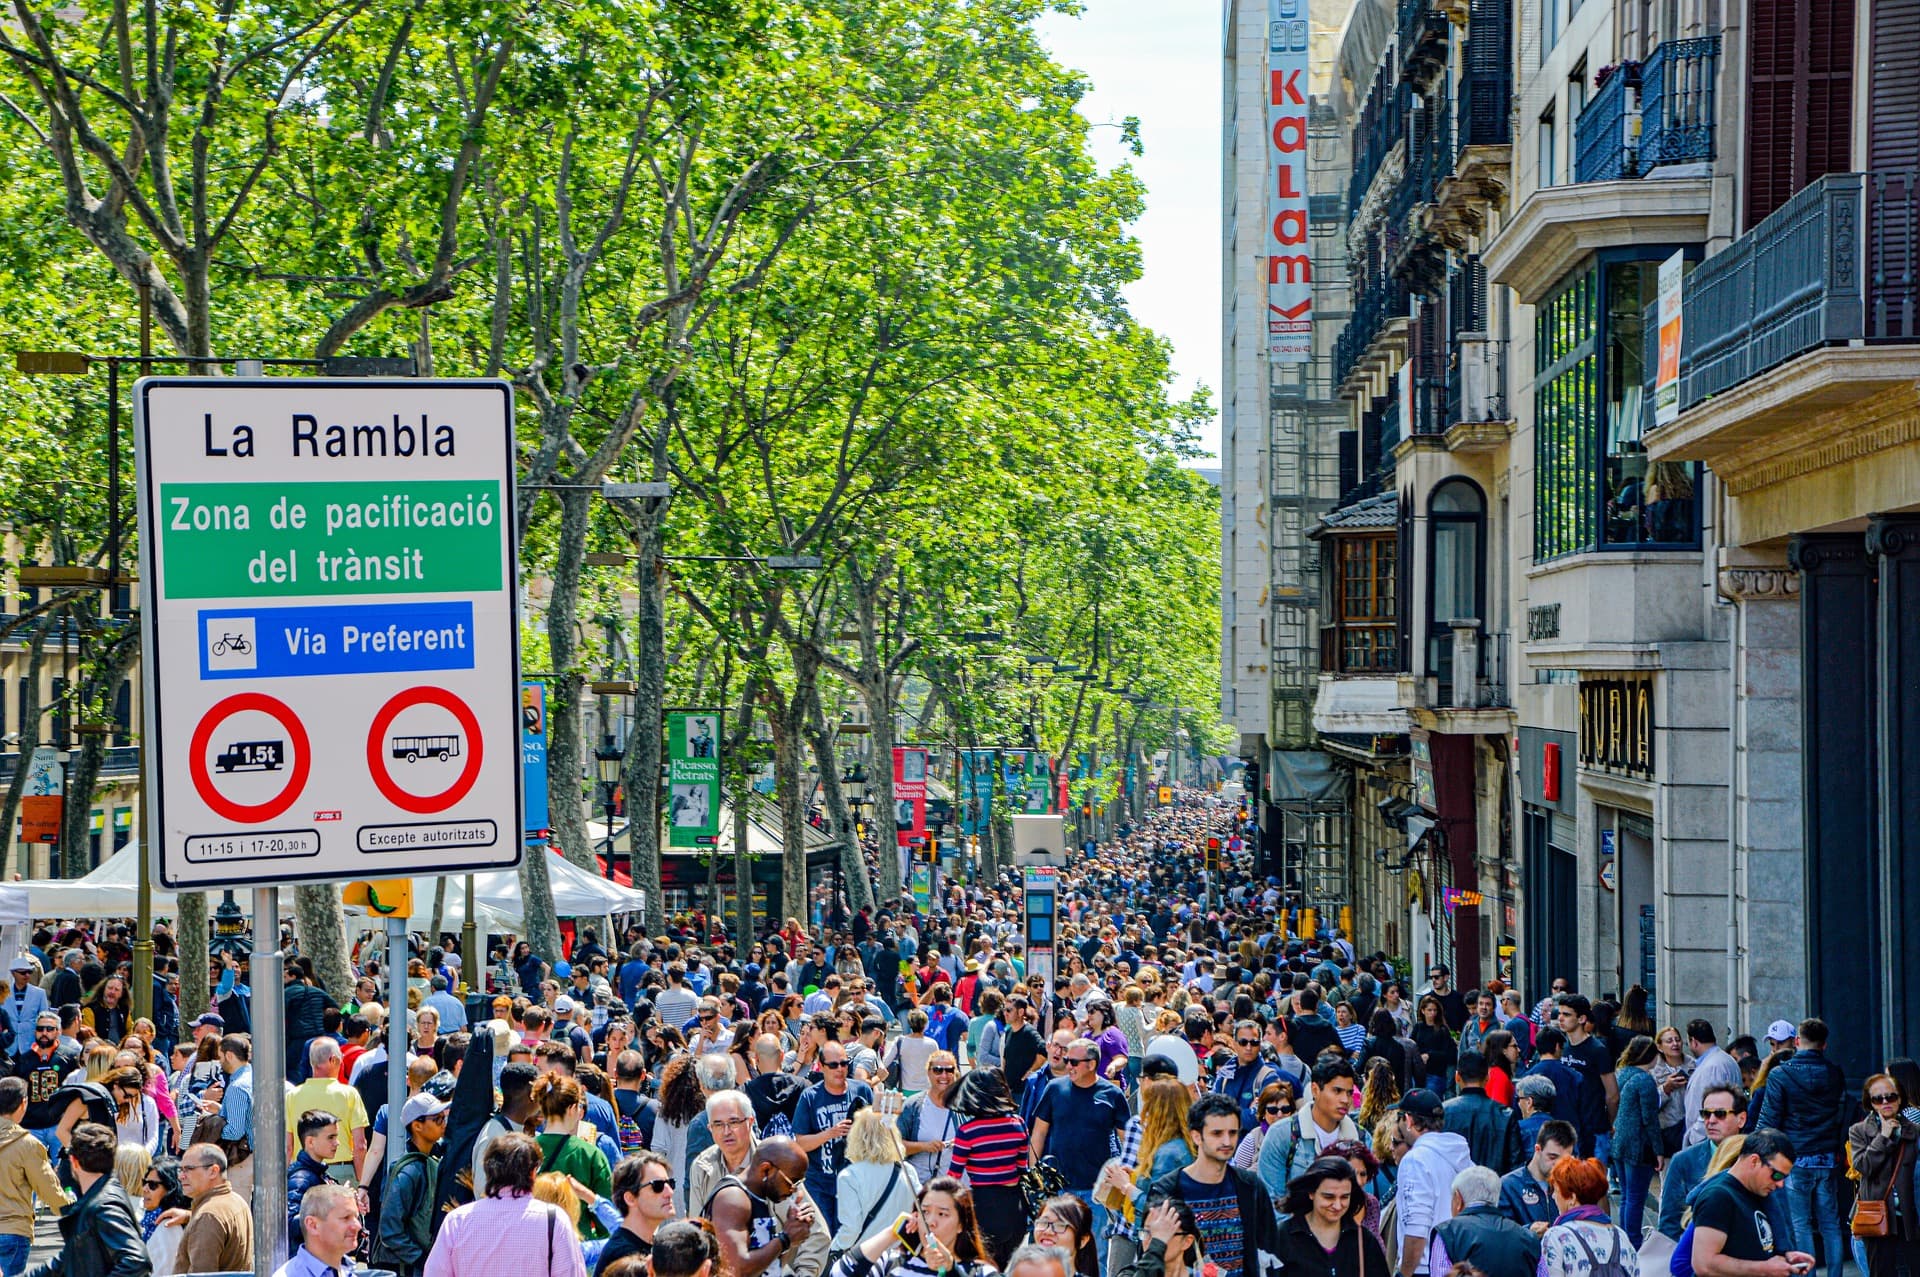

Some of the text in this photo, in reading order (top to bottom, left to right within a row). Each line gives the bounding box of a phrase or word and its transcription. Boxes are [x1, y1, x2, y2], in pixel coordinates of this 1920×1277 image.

[205, 413, 455, 458] La Rambla
[171, 493, 493, 536] Zona de pacificació
[248, 547, 424, 584] del trànsit
[285, 624, 466, 656] Via Preferent
[672, 759, 718, 770] Picasso.
[672, 770, 715, 781] Retrats
[200, 842, 233, 856] 11-15
[240, 841, 244, 853] i
[369, 829, 486, 846] Excepte autoritzats
